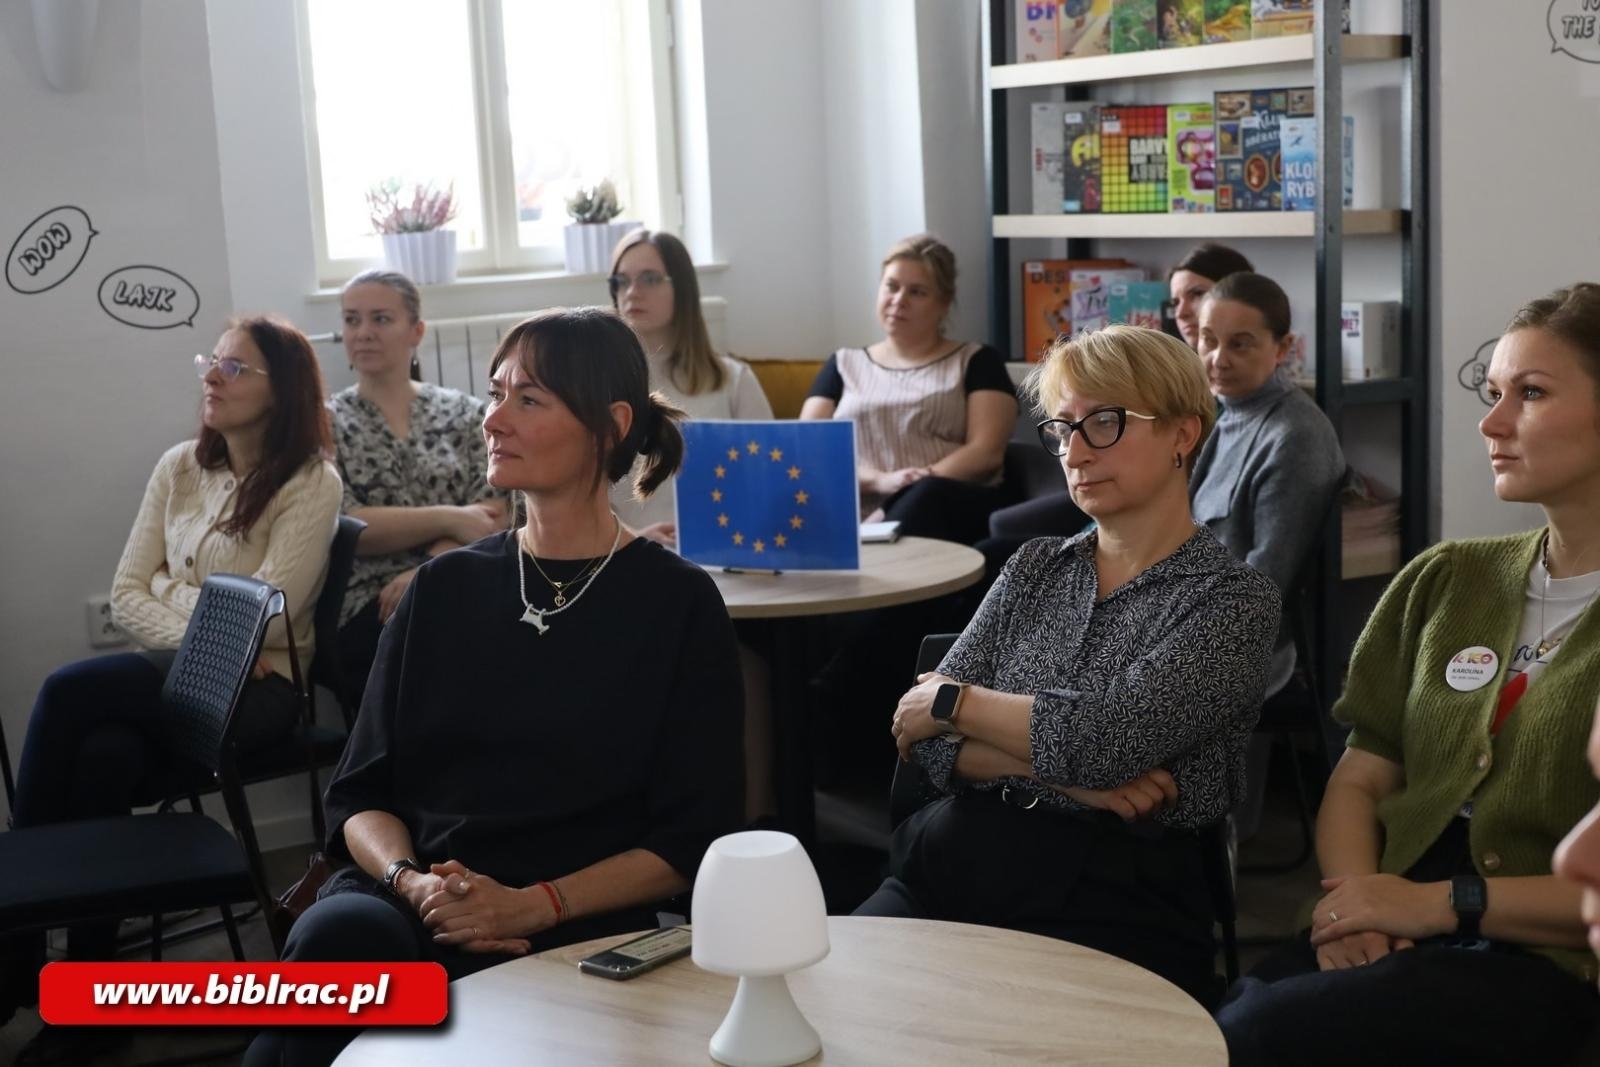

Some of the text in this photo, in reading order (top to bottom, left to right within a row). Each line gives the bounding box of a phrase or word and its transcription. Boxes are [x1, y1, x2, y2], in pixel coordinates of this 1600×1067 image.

[1561, 15, 1596, 39] THE
[18, 222, 71, 276] WOW
[113, 280, 176, 312] LAJK
[1452, 667, 1484, 675] KAROLINA
